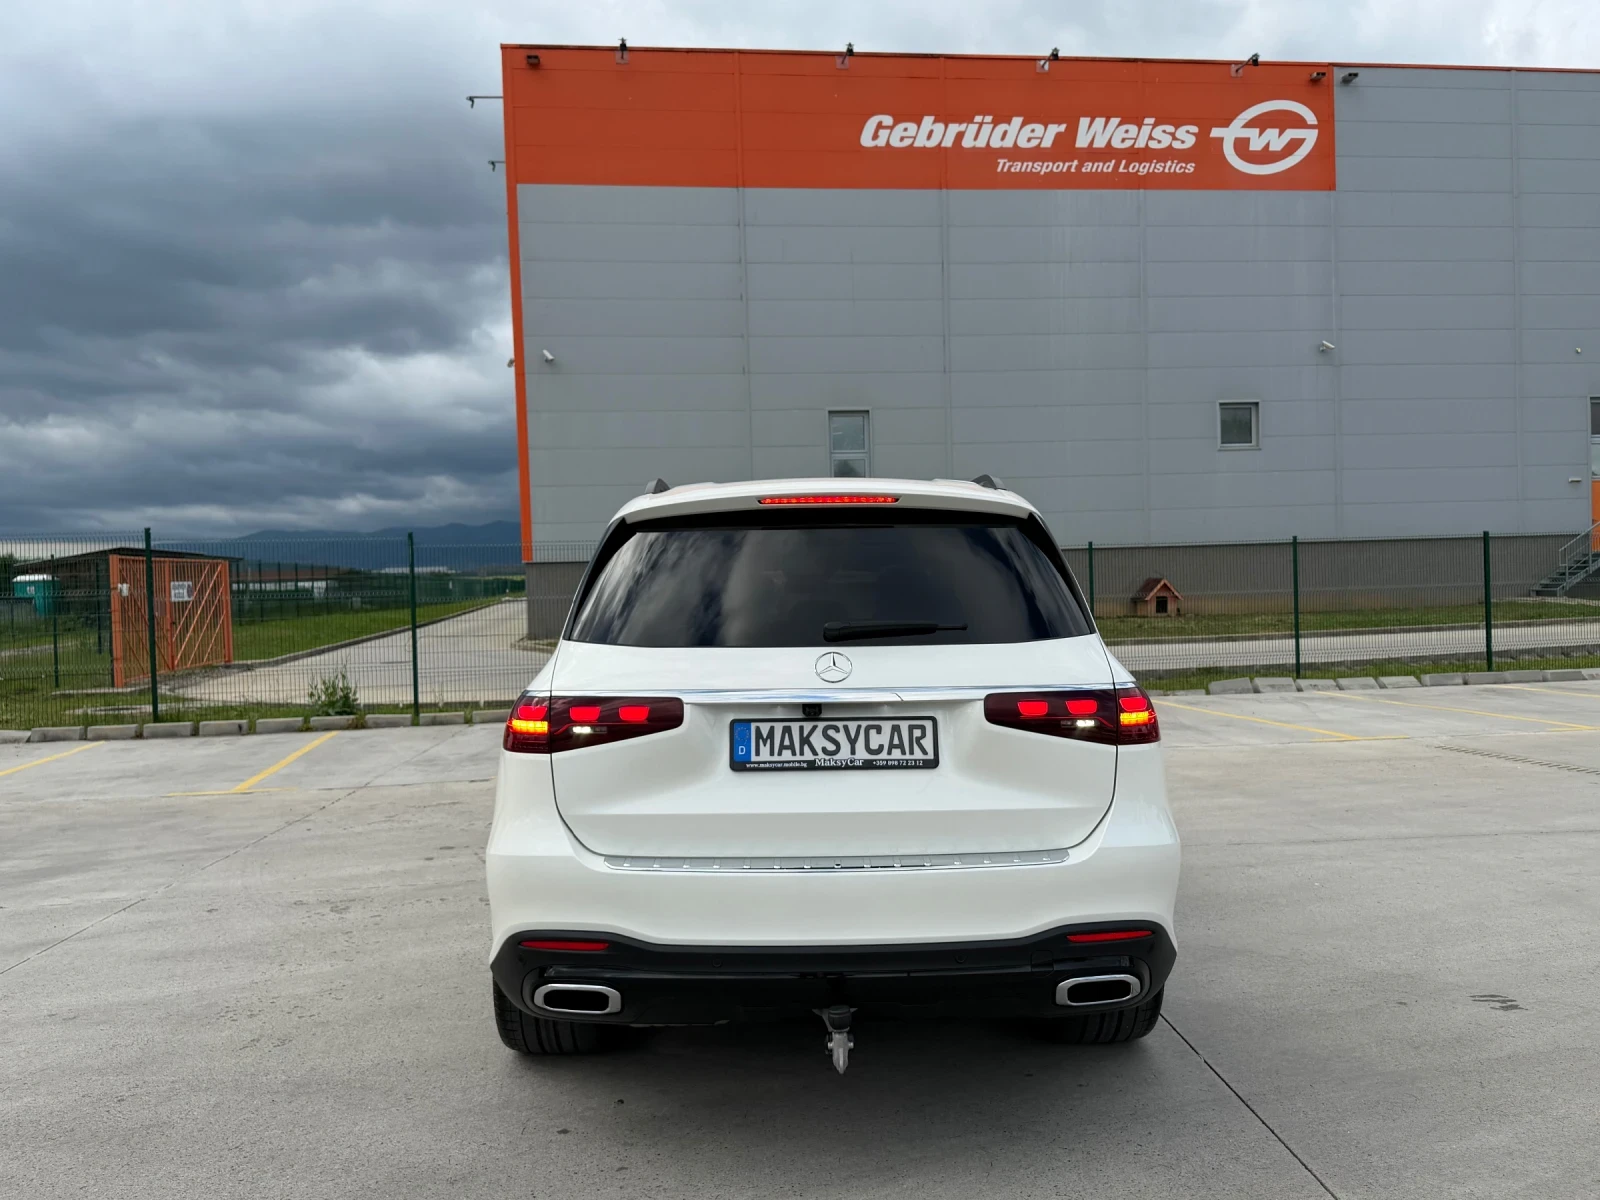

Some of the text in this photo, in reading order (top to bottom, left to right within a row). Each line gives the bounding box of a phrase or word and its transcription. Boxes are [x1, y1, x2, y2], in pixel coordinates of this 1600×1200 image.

[860, 114, 1199, 149] Gebrüder Weiss
[996, 158, 1196, 175] Transport and Logistics
[755, 724, 929, 757] MAKSYCAR
[738, 745, 746, 755] D
[814, 757, 864, 768] MaksyCar
